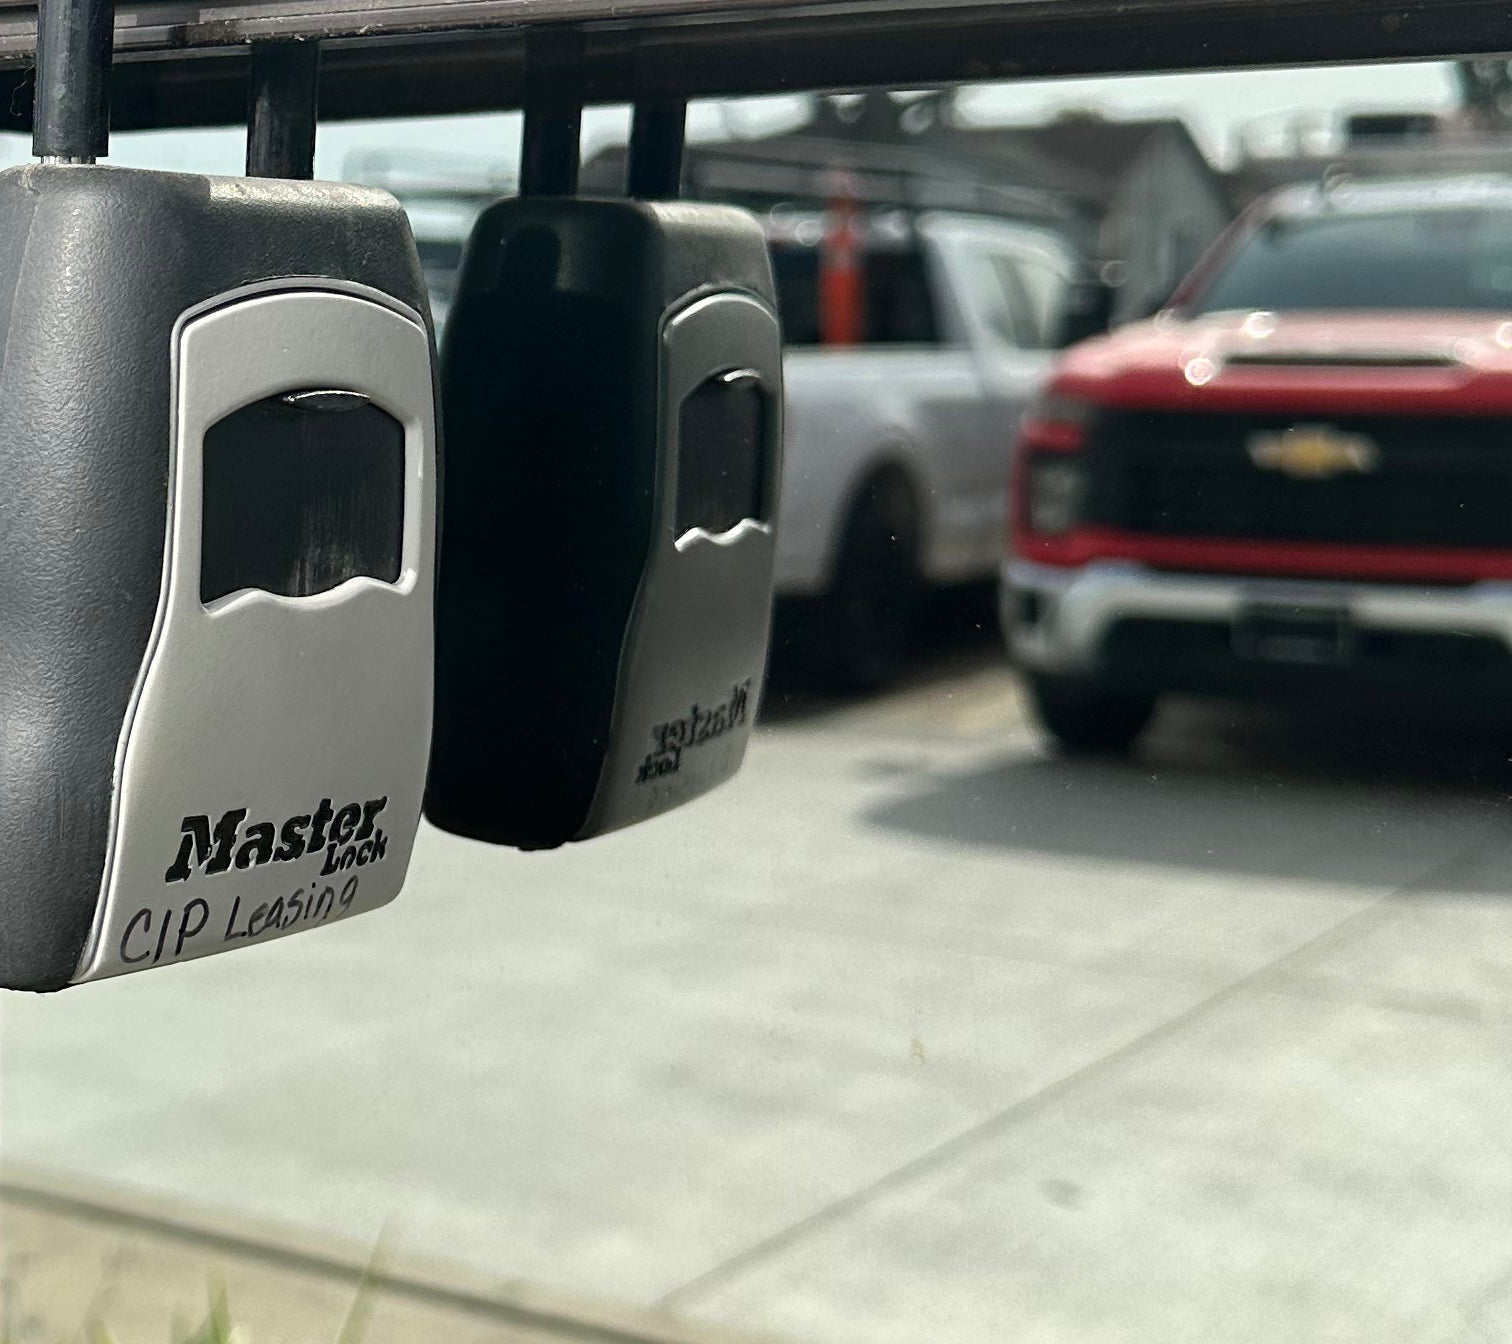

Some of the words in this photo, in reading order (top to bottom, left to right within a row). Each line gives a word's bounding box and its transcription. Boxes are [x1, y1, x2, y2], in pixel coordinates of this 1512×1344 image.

[165, 795, 388, 883] Master
[320, 827, 388, 877] Lock
[119, 898, 210, 964] CIP
[223, 875, 359, 943] Leasing
